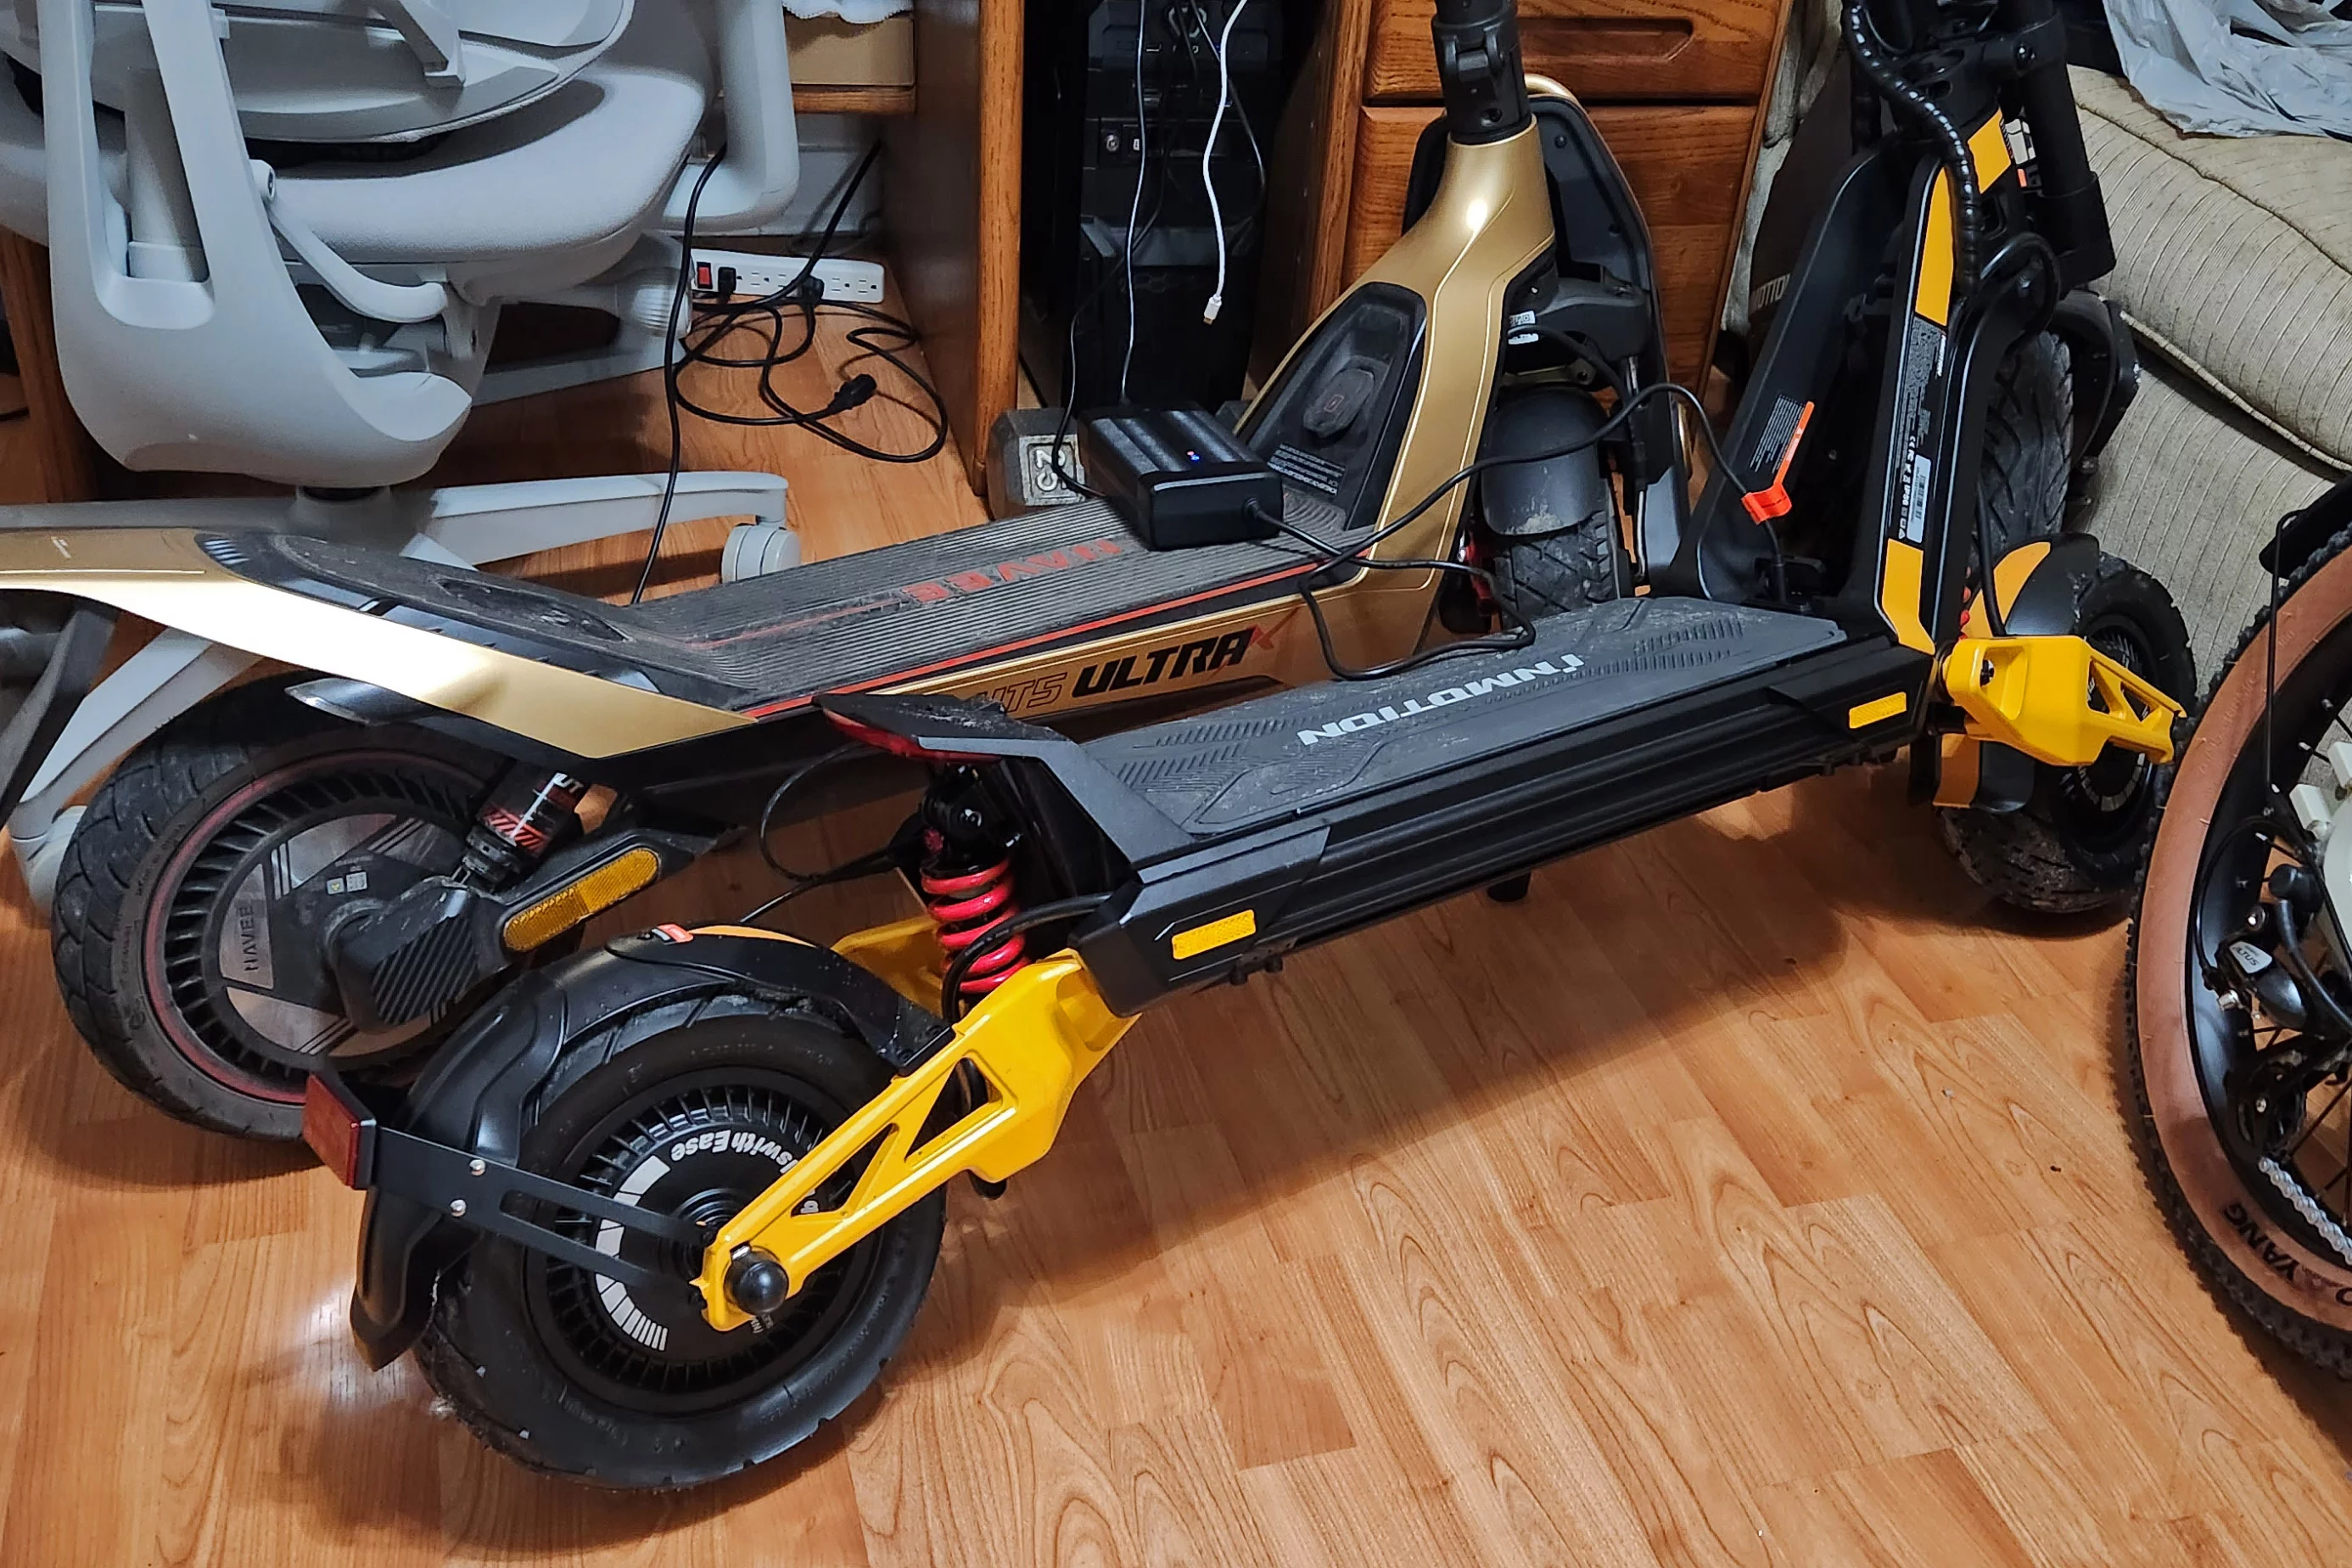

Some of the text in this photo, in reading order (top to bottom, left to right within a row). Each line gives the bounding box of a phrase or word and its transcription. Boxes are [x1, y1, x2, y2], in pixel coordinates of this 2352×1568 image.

[1035, 449, 1067, 492] 25
[1072, 628, 1257, 698] ULTRA
[238, 904, 259, 972] NAVEE
[670, 1129, 731, 1162] Ease
[2223, 1201, 2300, 1282] YANG
